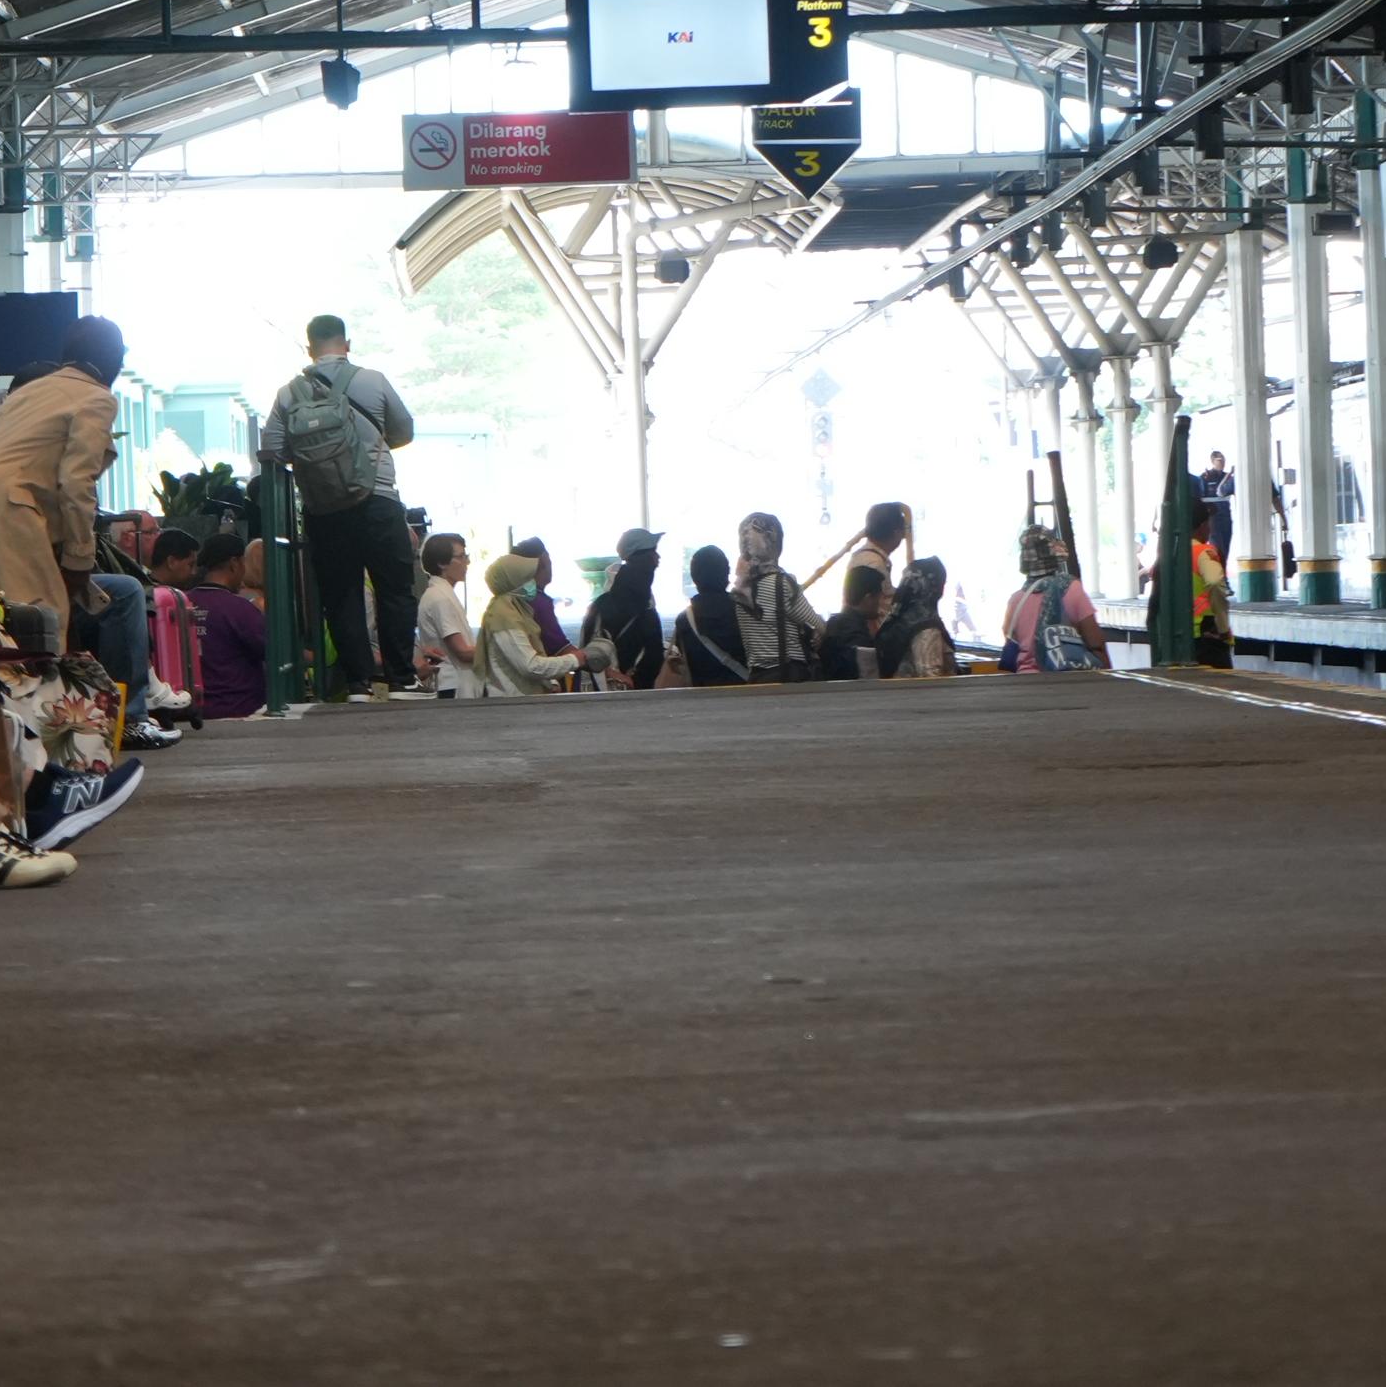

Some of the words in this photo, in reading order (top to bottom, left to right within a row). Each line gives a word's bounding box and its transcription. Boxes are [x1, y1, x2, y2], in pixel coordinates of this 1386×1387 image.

[796, 0, 843, 12] Platform
[808, 16, 833, 48] 3
[470, 123, 547, 139] Dilarang
[758, 120, 794, 130] TRACK
[470, 142, 551, 159] merokok
[470, 164, 488, 175] No
[491, 163, 543, 176] smoking
[794, 151, 821, 177] 3
